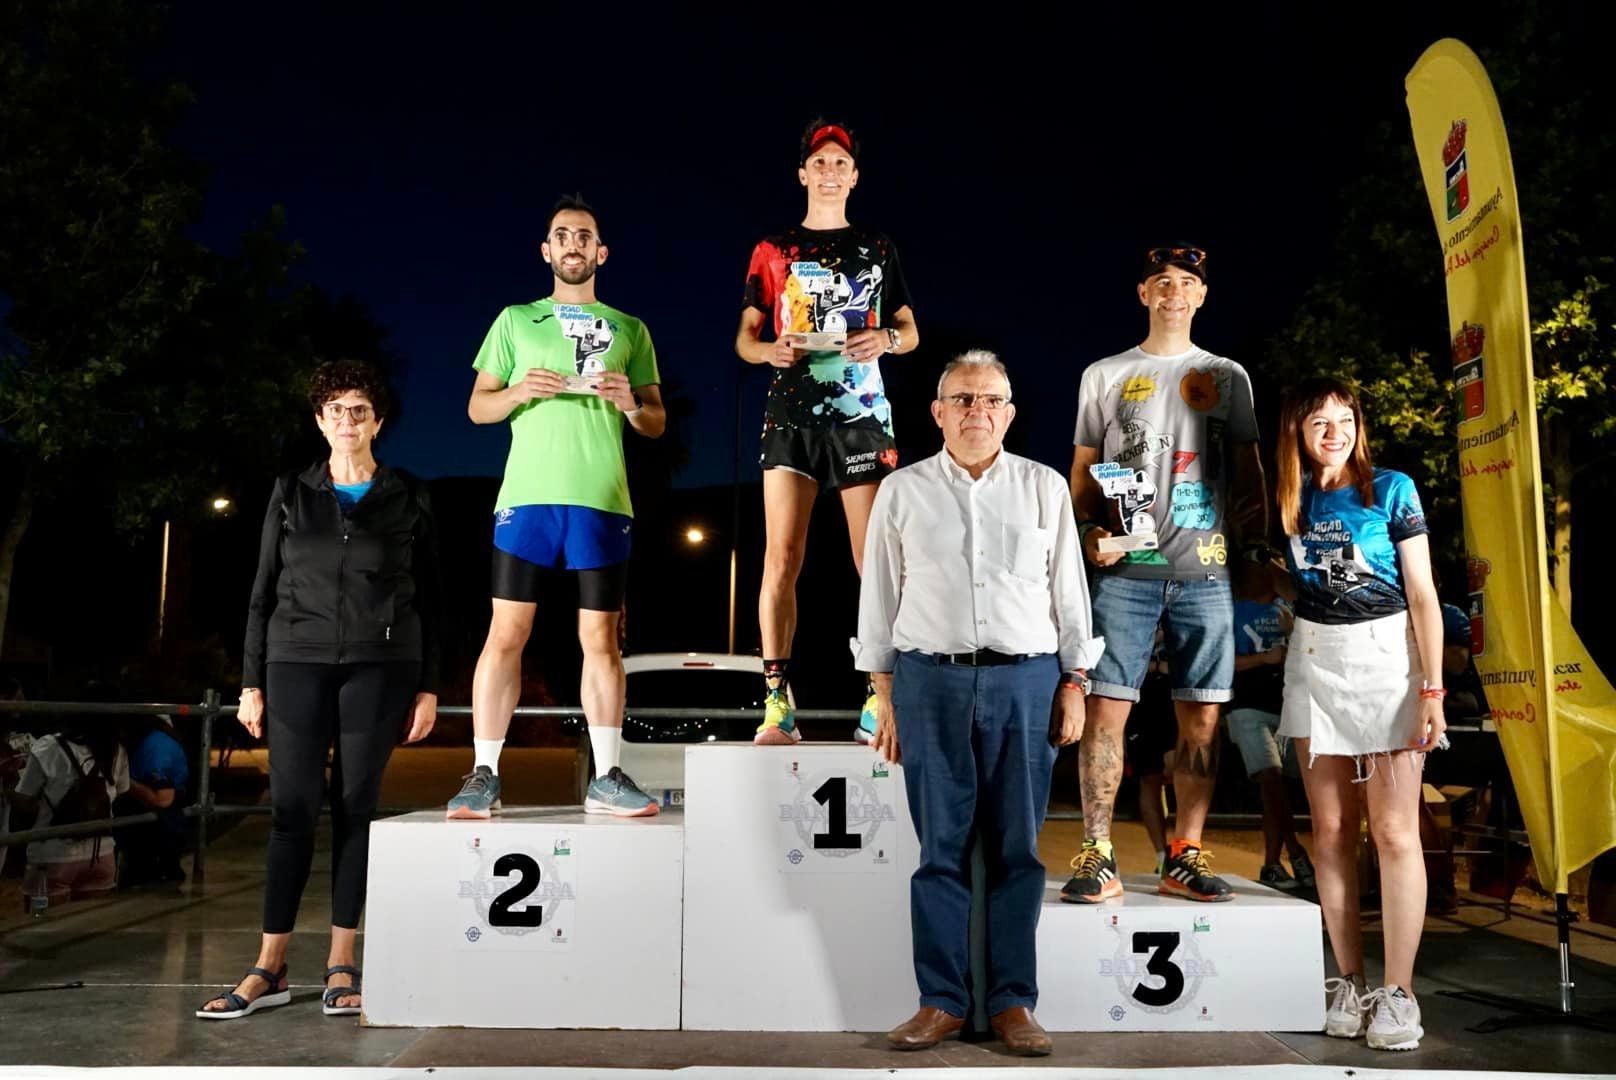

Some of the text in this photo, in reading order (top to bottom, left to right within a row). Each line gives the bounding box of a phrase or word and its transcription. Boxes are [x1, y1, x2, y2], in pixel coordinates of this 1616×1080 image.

[845, 451, 878, 465] SIEMPRE
[846, 462, 876, 475] FUERTES
[812, 776, 862, 849] 1
[488, 853, 543, 927] 2
[1132, 931, 1185, 1007] 3
